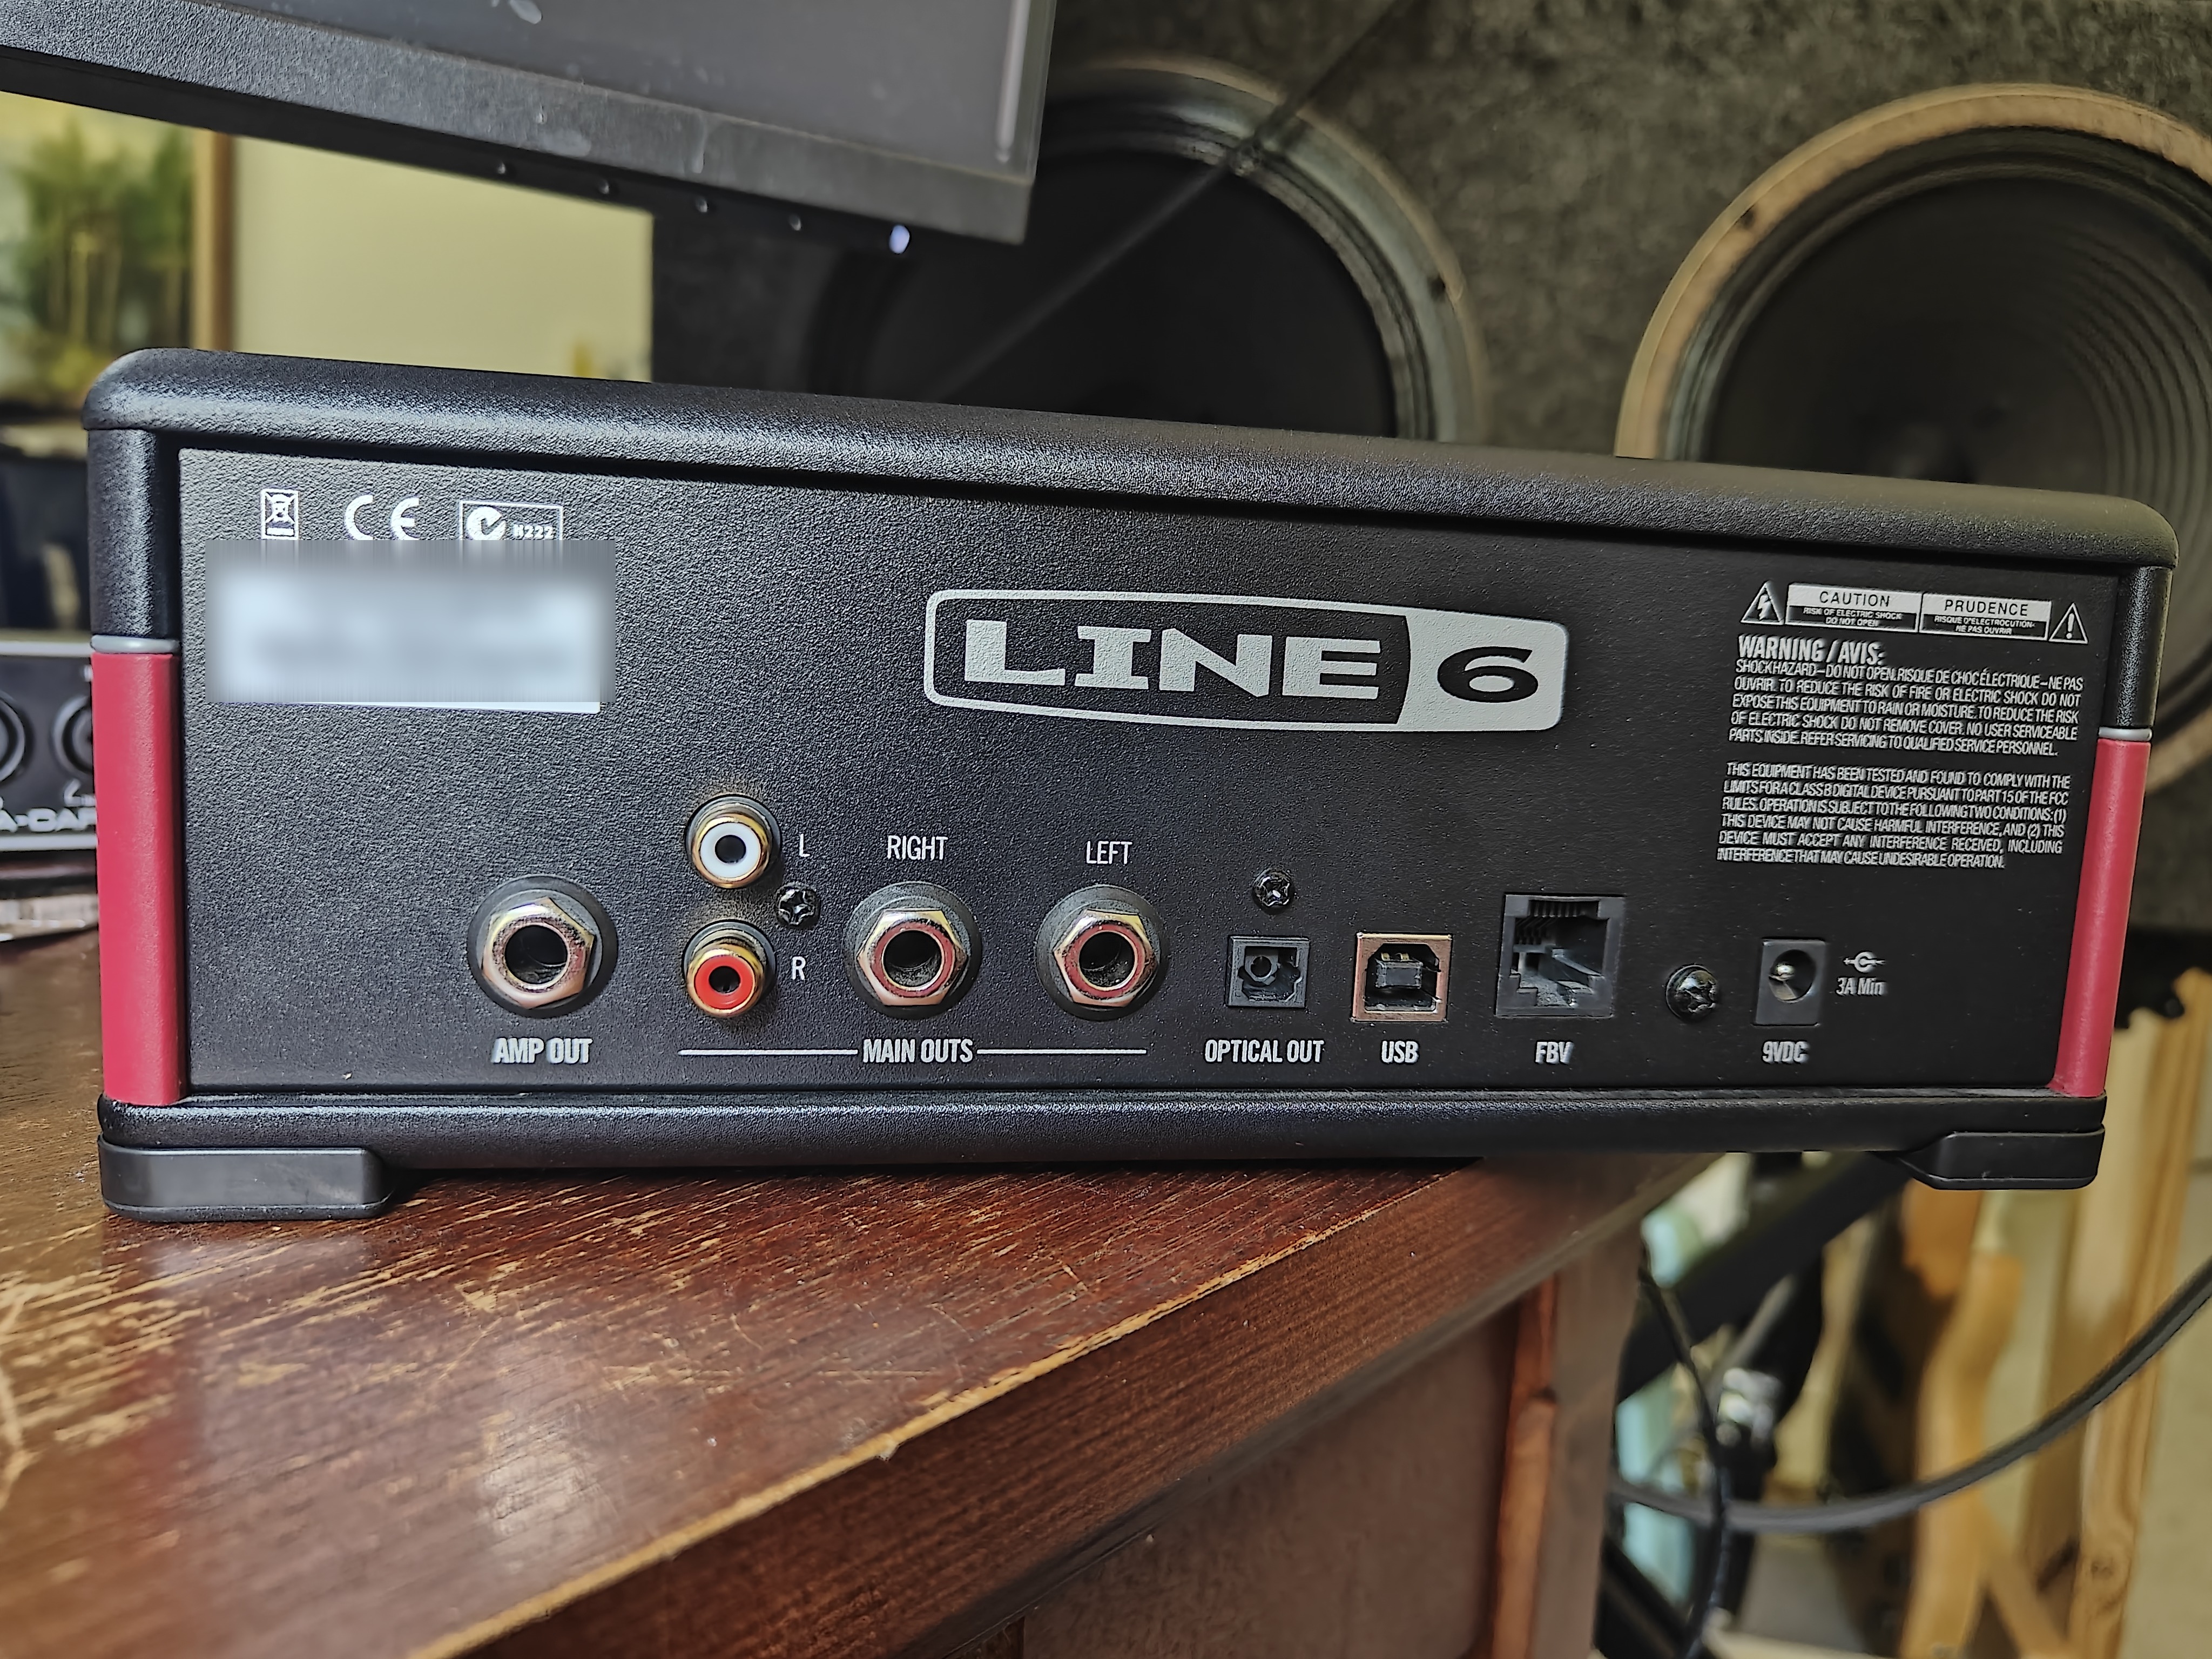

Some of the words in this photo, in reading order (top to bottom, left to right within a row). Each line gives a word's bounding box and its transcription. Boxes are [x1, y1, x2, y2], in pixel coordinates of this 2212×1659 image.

[1820, 591, 1890, 606] CAUTION
[1945, 599, 2028, 616] PRUDENCE
[1803, 607, 1823, 615] RISK
[1824, 608, 1835, 616] OF
[1836, 609, 1874, 618] ELECTRIC
[1875, 611, 1902, 620] SHOCK
[1934, 616, 1963, 624] RISQUE
[1967, 625, 1982, 633] PAS
[965, 619, 1381, 700] LINE
[1436, 646, 1540, 703] 6
[1738, 635, 1825, 662] WARNING
[1838, 640, 1885, 665] AVIS:
[1736, 660, 1772, 675] SHOCK
[1843, 665, 1866, 679] NOT
[1898, 667, 1934, 683] RISQUE
[1936, 669, 1951, 684] DE
[1951, 670, 1979, 685] CHOC
[2063, 675, 2083, 691] PAS
[1779, 678, 1794, 693] TO
[1796, 679, 1842, 695] REDUCE
[1842, 682, 1864, 696] THE
[1865, 683, 1890, 697] RISK
[1892, 684, 1908, 698] OF
[1909, 685, 1932, 699] FIRE
[1935, 686, 1951, 700] OR
[1952, 687, 2001, 703] ELECTRIC
[2003, 690, 2039, 705] SHOCK
[2041, 692, 2057, 705] DO
[2060, 692, 2081, 706] NOT
[1732, 694, 1776, 710] EXPOSE
[1776, 696, 1799, 711] THIS
[1800, 698, 1863, 714] EQUIPMENT
[1863, 700, 1877, 714] TO
[1877, 701, 1904, 716] RAIN
[1905, 703, 1920, 717] OR
[1978, 706, 1992, 720] TO
[1993, 707, 2034, 722] REDUCE
[2035, 709, 2055, 723] THE
[2056, 710, 2079, 724] RISK
[1731, 711, 1748, 725] OF
[1748, 712, 1800, 727] ELECTRIC
[1802, 714, 1839, 730] SHOCK
[1841, 716, 1857, 730] DO
[1859, 717, 1883, 731] NOT
[1883, 718, 1927, 733] REMOVE
[1967, 721, 1983, 736] NO
[1984, 723, 2012, 737] USER
[2012, 724, 2078, 740] SERVICEABLE
[1729, 728, 1763, 743] PARTS
[1800, 731, 1835, 746] REFER
[1835, 733, 1889, 748] SERVICING
[1889, 735, 1902, 749] TO
[1903, 736, 1954, 751] QUALIFIED
[1954, 738, 1996, 753] SERVICE
[1997, 740, 2059, 756] PERSONNEL.
[1727, 761, 1751, 777] THIS
[1752, 763, 1813, 779] EQUIPMENT
[1813, 765, 1836, 780] HAS
[1837, 766, 1865, 781] BEEN
[1866, 767, 1905, 783] TESTED
[1905, 768, 1929, 784] AND
[1931, 770, 1965, 785] FOUND
[1967, 771, 1981, 786] TO
[1984, 772, 2024, 787] COMPLY
[2025, 773, 2051, 788] WITH
[2052, 774, 2071, 790] THE
[1724, 780, 1759, 794] LIMITS
[1759, 781, 1782, 795] FOR
[1789, 782, 1823, 797] CLASS
[1832, 784, 1870, 798] DIGITAL
[1871, 785, 1907, 799] DEVICE
[1907, 786, 1961, 801] PURSUANT
[1961, 788, 1974, 801] TO
[1974, 788, 2001, 802] PART
[2002, 789, 2014, 803] 15
[2015, 790, 2029, 804] OF
[2029, 790, 2048, 804] THE
[2049, 791, 2069, 805] FCC
[1759, 798, 1817, 813] OPERATION
[1818, 799, 1828, 813] IS
[1829, 800, 1875, 815] SUBJECT
[1876, 801, 1890, 815] TO
[1890, 802, 1910, 816] THE
[1910, 802, 1968, 818] FOLLOWING
[1968, 805, 1992, 819] TWO
[1993, 805, 2053, 821] CONDITIONS:
[1721, 813, 1746, 828] THIS
[1748, 814, 1786, 829] DEVICE
[1788, 815, 1812, 830] MAY
[1812, 817, 1837, 831] NOT
[1837, 817, 1873, 832] CAUSE
[1874, 818, 1924, 833] HARMFUL
[2003, 822, 2025, 836] AND
[2027, 823, 2041, 839] (2)
[2042, 824, 2065, 838] THIS
[799, 833, 810, 857] L
[887, 835, 948, 860] RIGHT
[1087, 840, 1132, 864] LEFT
[1719, 831, 1762, 845] DEVICE
[1763, 832, 1797, 846] MUST
[1797, 833, 1842, 847] ACCEPT
[1842, 834, 1866, 848] ANY
[1870, 834, 1948, 851] INTERFERENCE
[1951, 837, 2004, 854] RECEIVED,
[2008, 839, 2063, 853] INCLUDING
[1717, 848, 1794, 863] INTERFERENCE
[1794, 849, 1820, 864] THAT
[1821, 850, 1844, 864] MAY
[1844, 851, 1879, 865] CAUSE
[1879, 852, 1947, 867] UNDESIRABLE
[792, 956, 806, 980] R
[1837, 977, 1856, 995] 3A
[1858, 977, 1885, 995] Min
[491, 1037, 544, 1063] AMP
[546, 1037, 593, 1063] OUT
[863, 1038, 915, 1063] MAIN
[921, 1038, 973, 1062] OUTS
[1205, 1040, 1283, 1062] OPTICAL
[1286, 1040, 1324, 1062] OUT
[1381, 1041, 1419, 1063] USB
[1535, 1042, 1574, 1064] FBV
[1762, 1041, 1809, 1062] 9VDC
